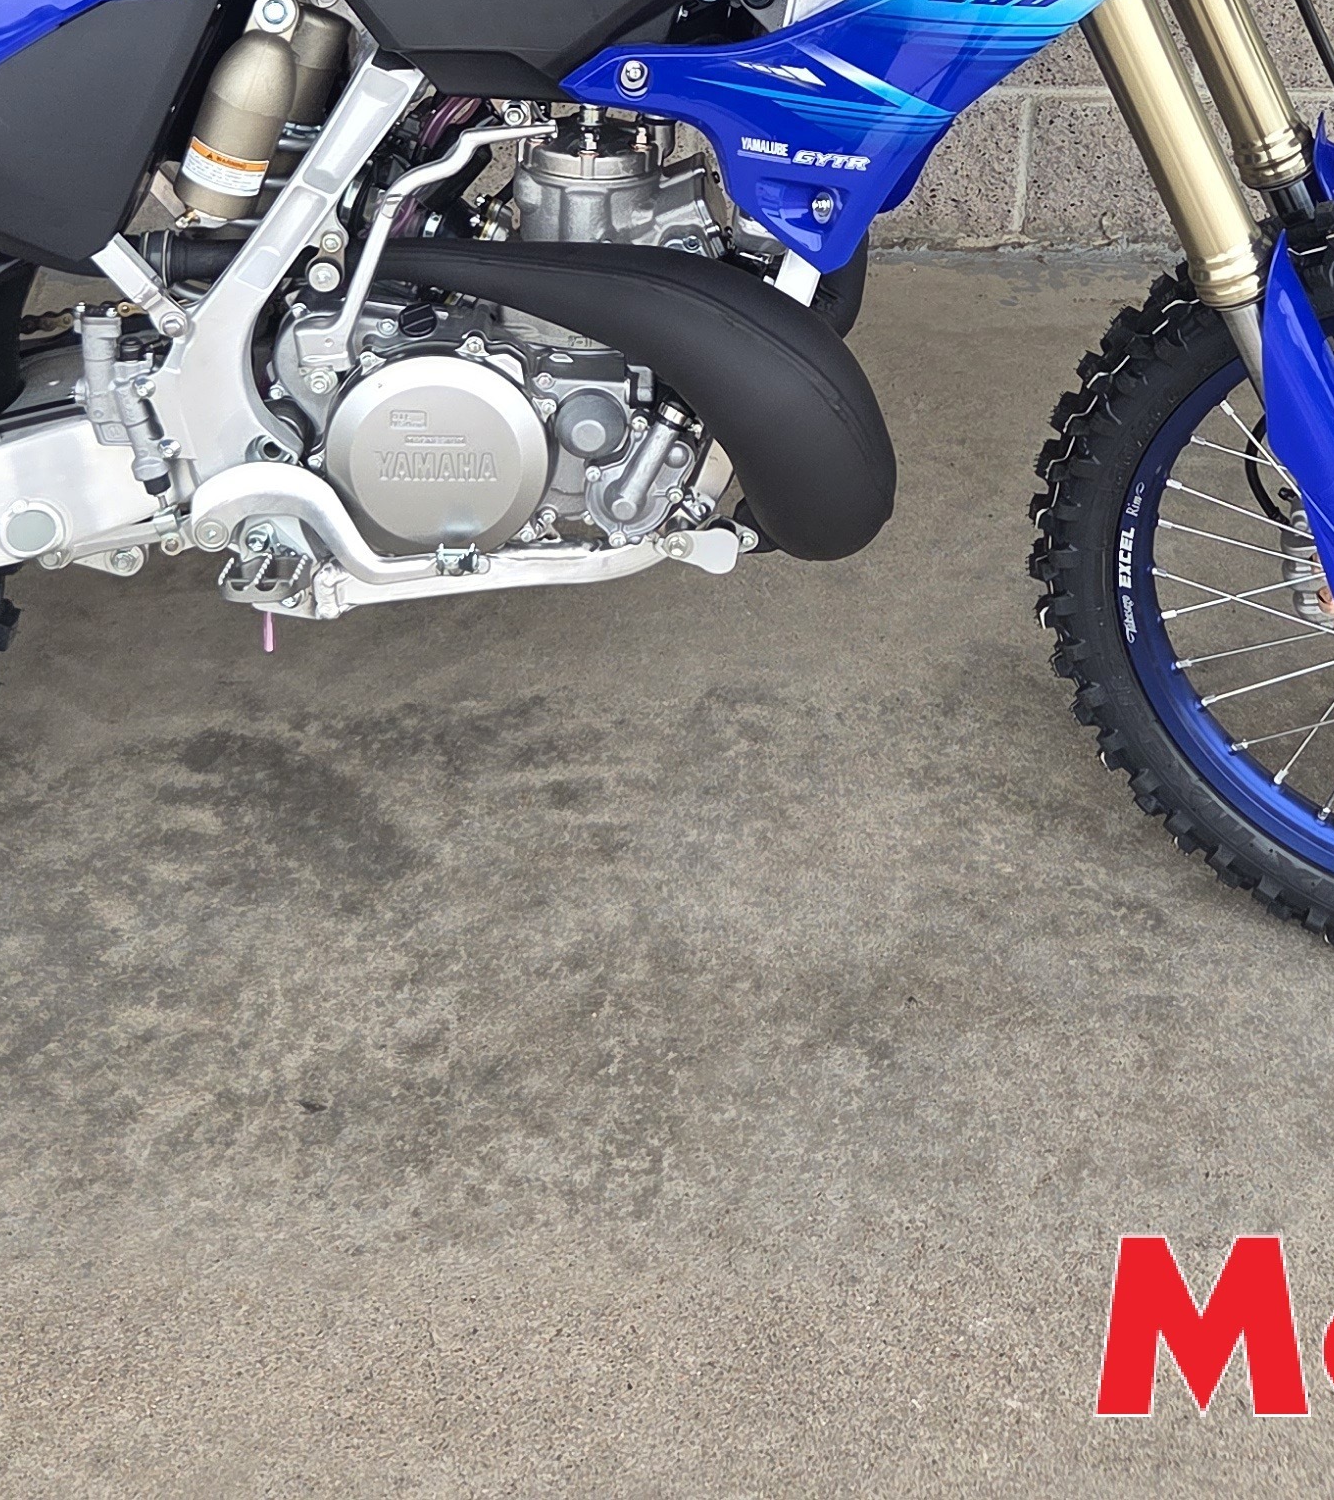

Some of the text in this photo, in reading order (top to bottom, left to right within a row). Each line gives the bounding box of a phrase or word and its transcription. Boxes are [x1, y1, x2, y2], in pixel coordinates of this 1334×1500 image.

[741, 137, 871, 171] YAMALUBE GYTR
[374, 451, 498, 483] YAMAHA
[1118, 526, 1136, 589] EXCEL
